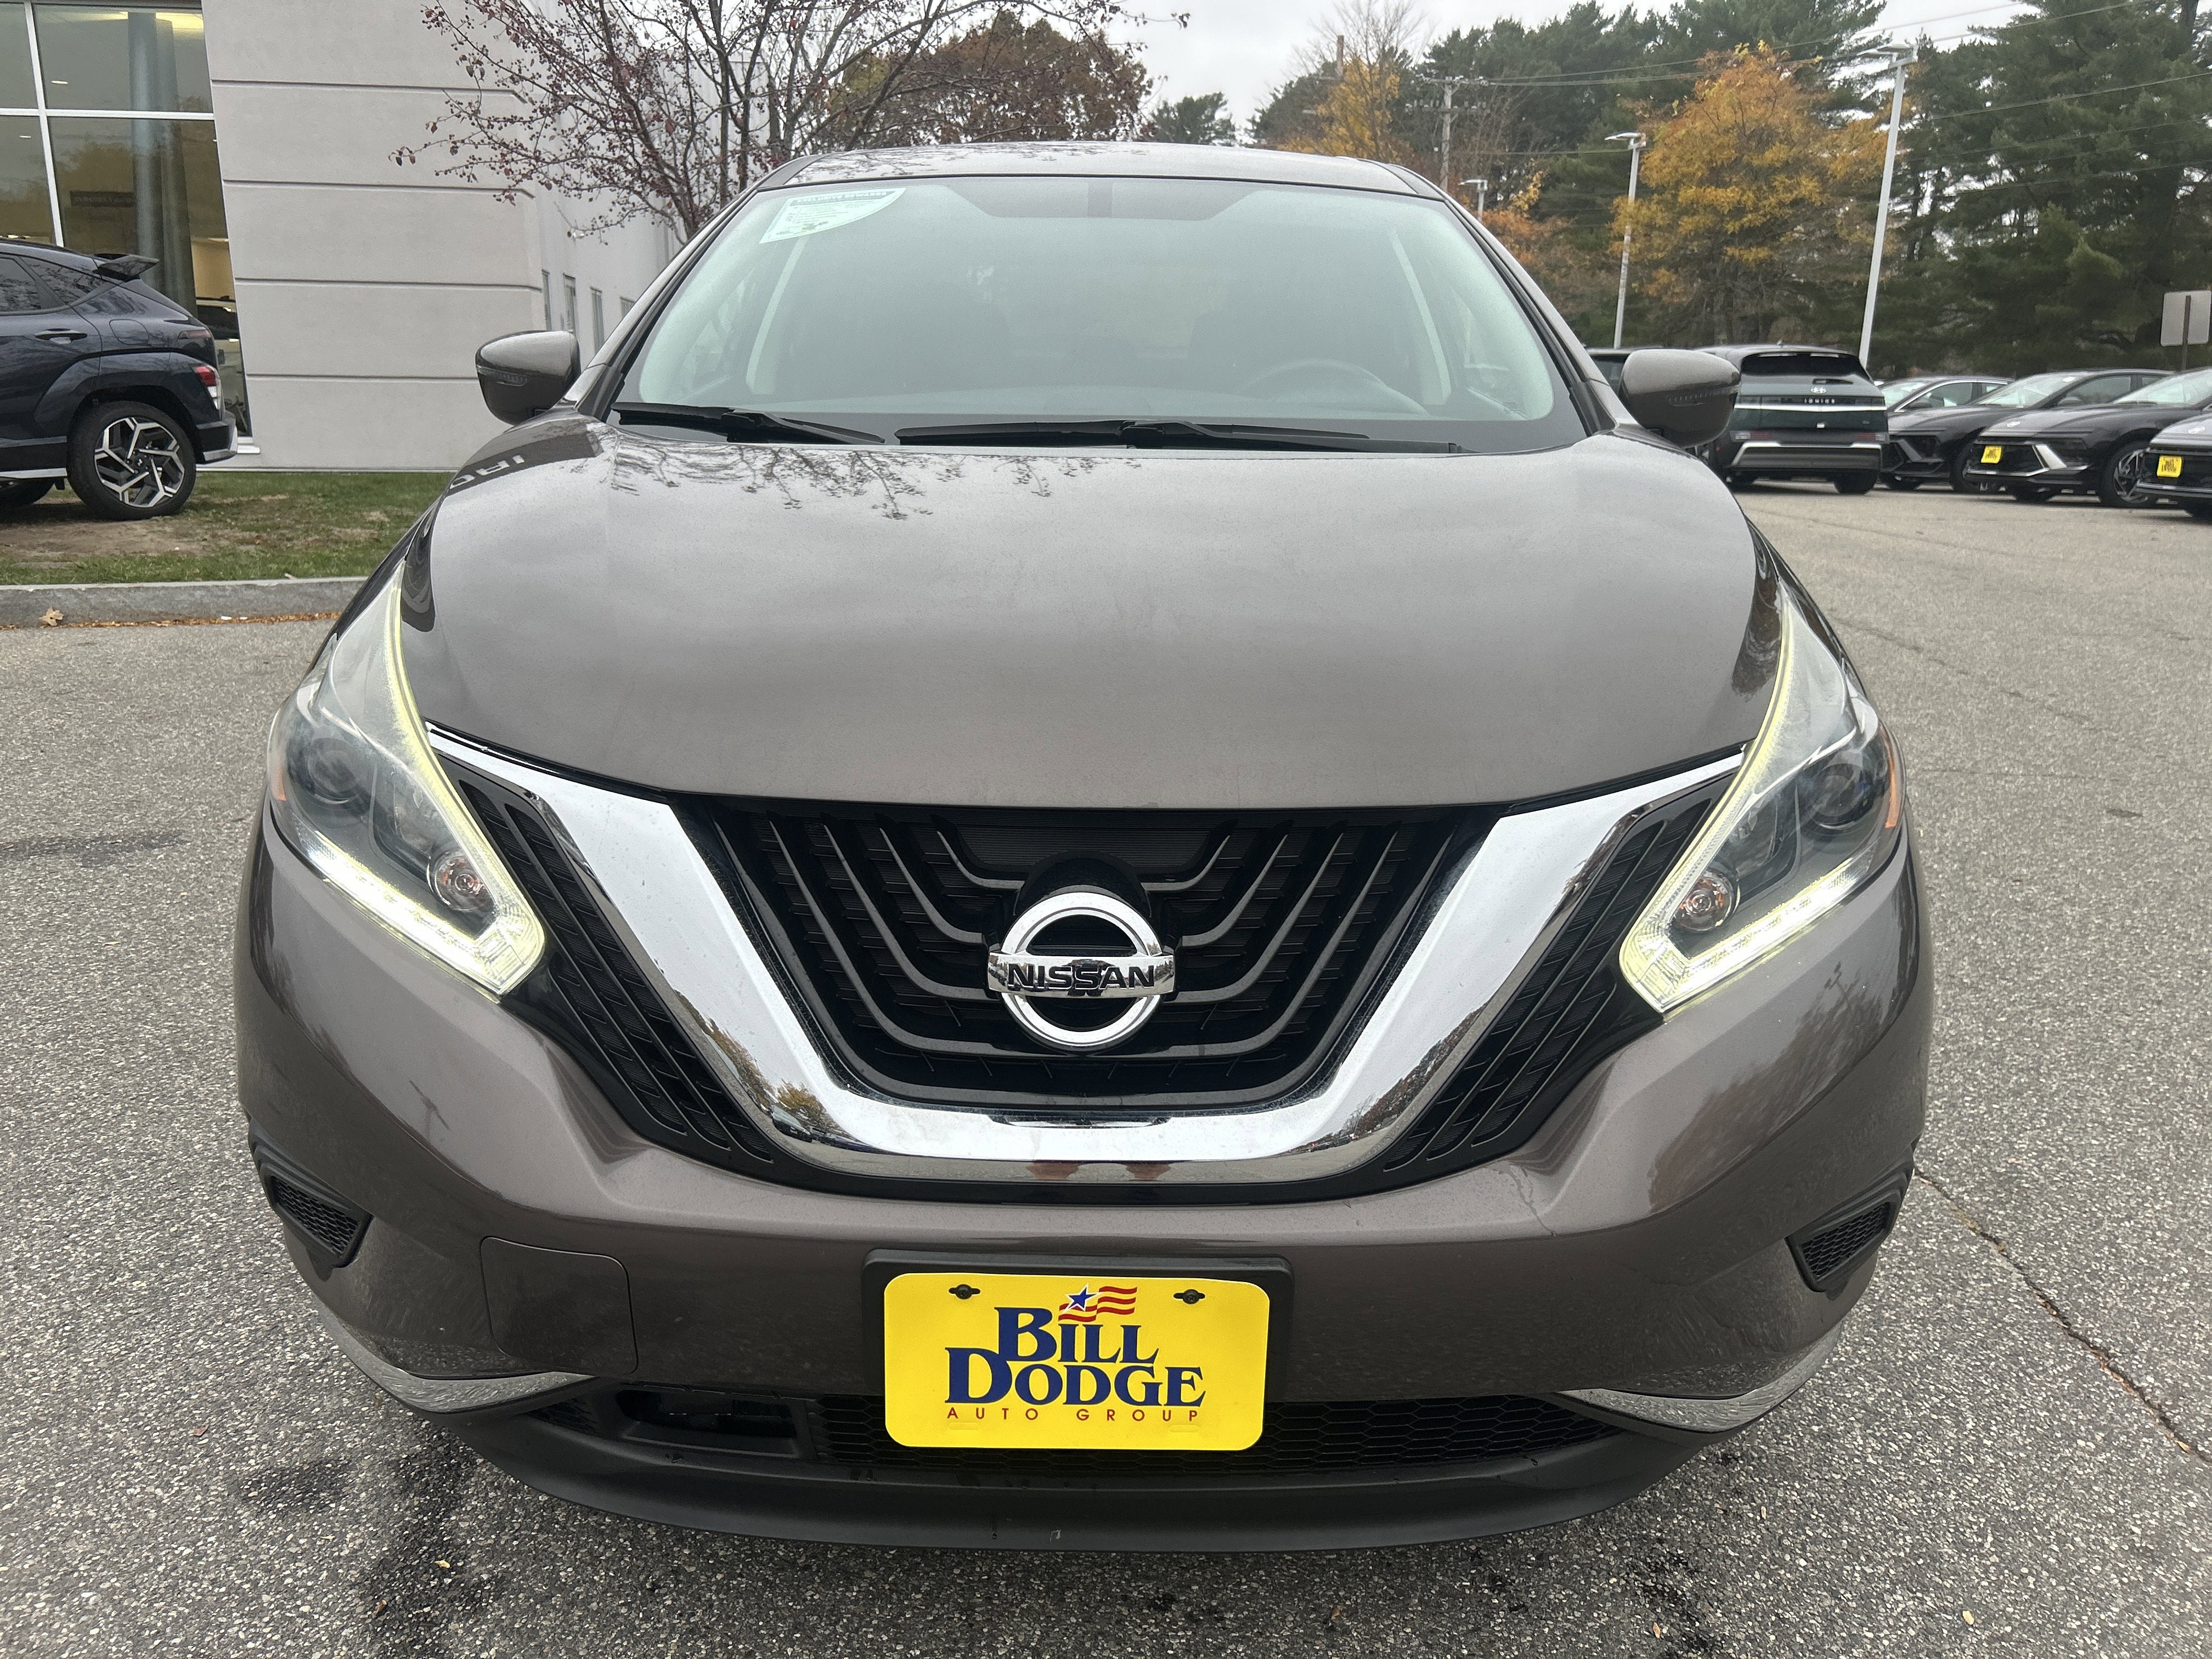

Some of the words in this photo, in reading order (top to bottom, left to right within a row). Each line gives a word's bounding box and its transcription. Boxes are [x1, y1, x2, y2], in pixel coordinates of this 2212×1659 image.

[1007, 964, 1154, 990] NISSAN
[994, 1306, 1159, 1364] BILL
[944, 1347, 1206, 1407] DODGE
[947, 1407, 1039, 1421] AUTO
[1076, 1409, 1198, 1422] GROUP
